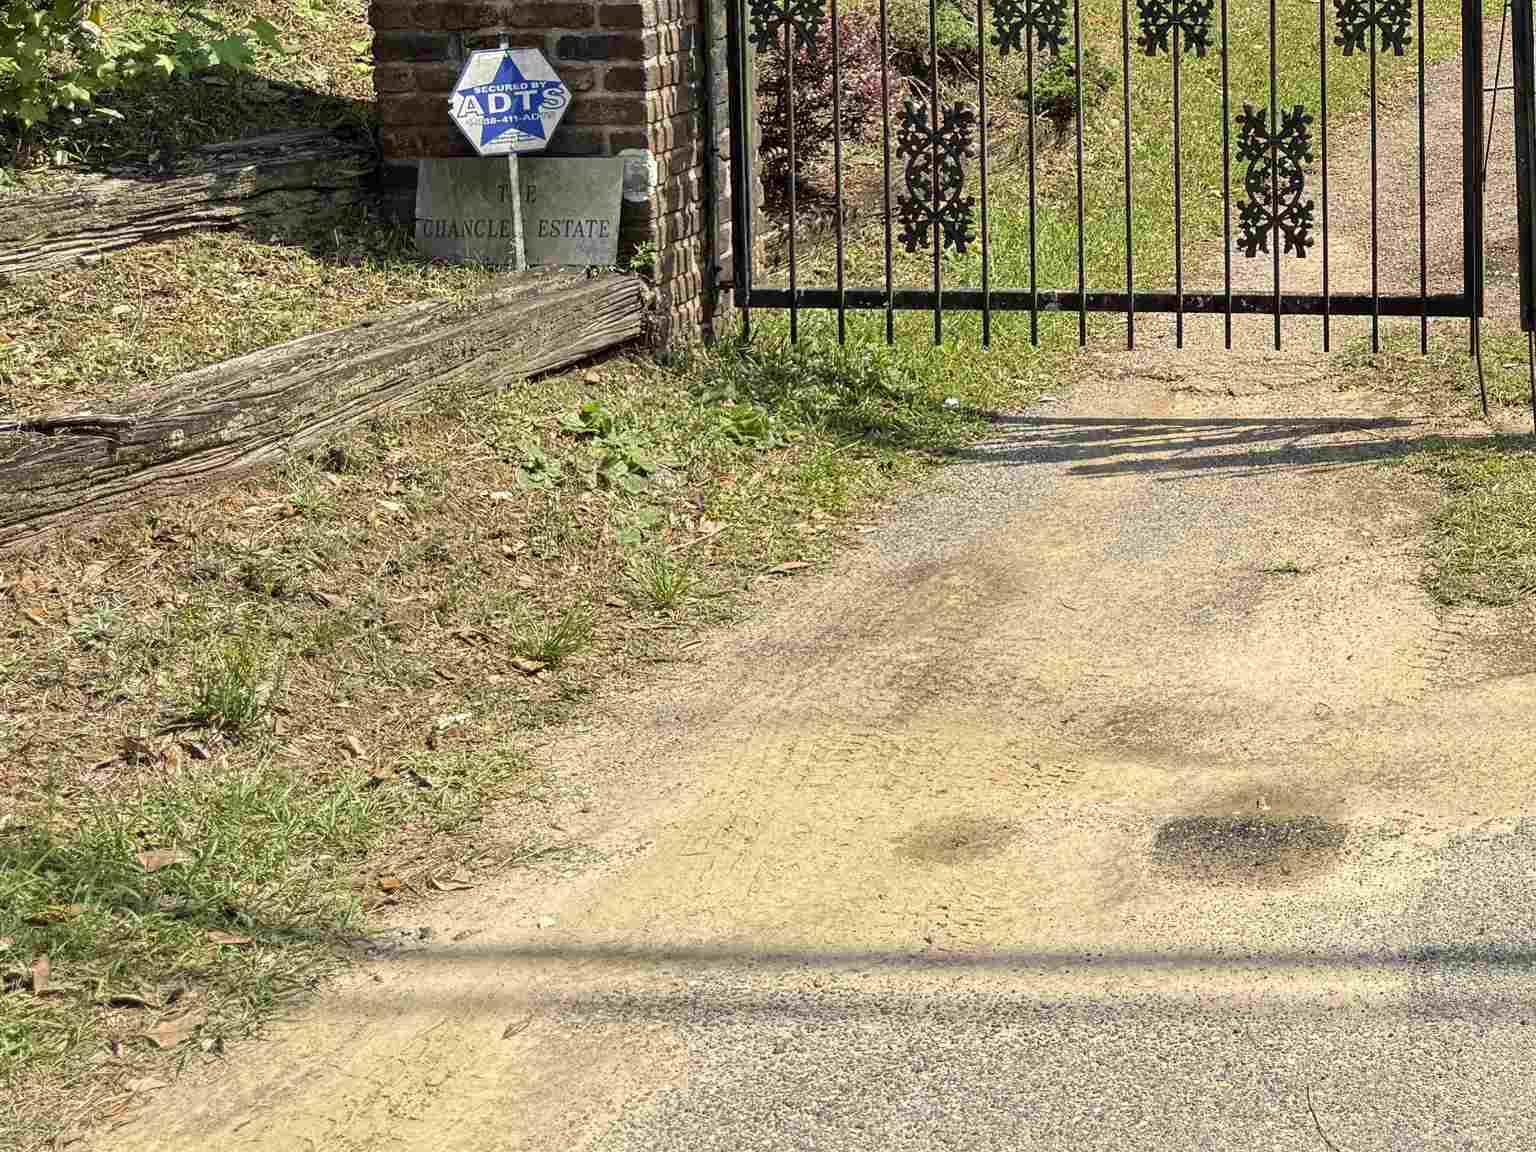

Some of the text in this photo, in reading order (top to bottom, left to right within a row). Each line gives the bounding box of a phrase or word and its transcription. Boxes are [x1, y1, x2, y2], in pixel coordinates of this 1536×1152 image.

[473, 80, 547, 95] SECURED BY
[457, 87, 566, 119] ADTS
[497, 184, 538, 204] TE
[423, 218, 610, 239] CHANCLE ESTATE
